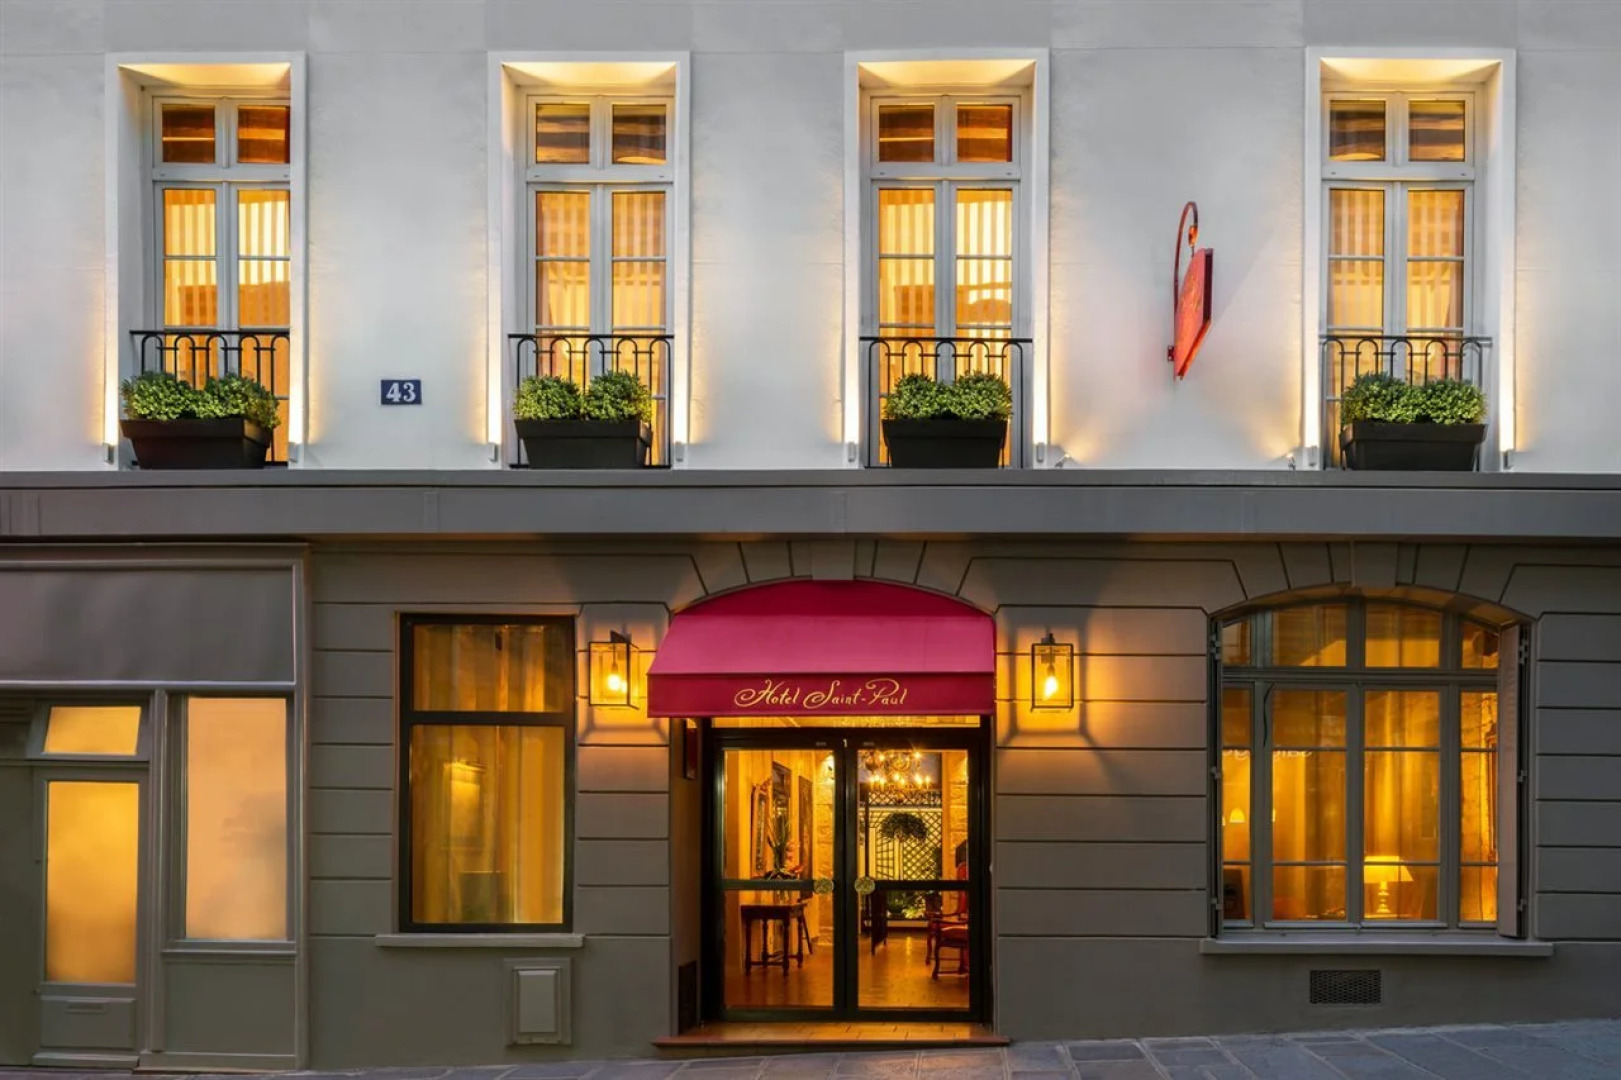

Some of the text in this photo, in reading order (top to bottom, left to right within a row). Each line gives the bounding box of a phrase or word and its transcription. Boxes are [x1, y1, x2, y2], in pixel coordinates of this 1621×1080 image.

[386, 382, 416, 402] 43
[734, 678, 908, 709] Hotel Saint-Paul
